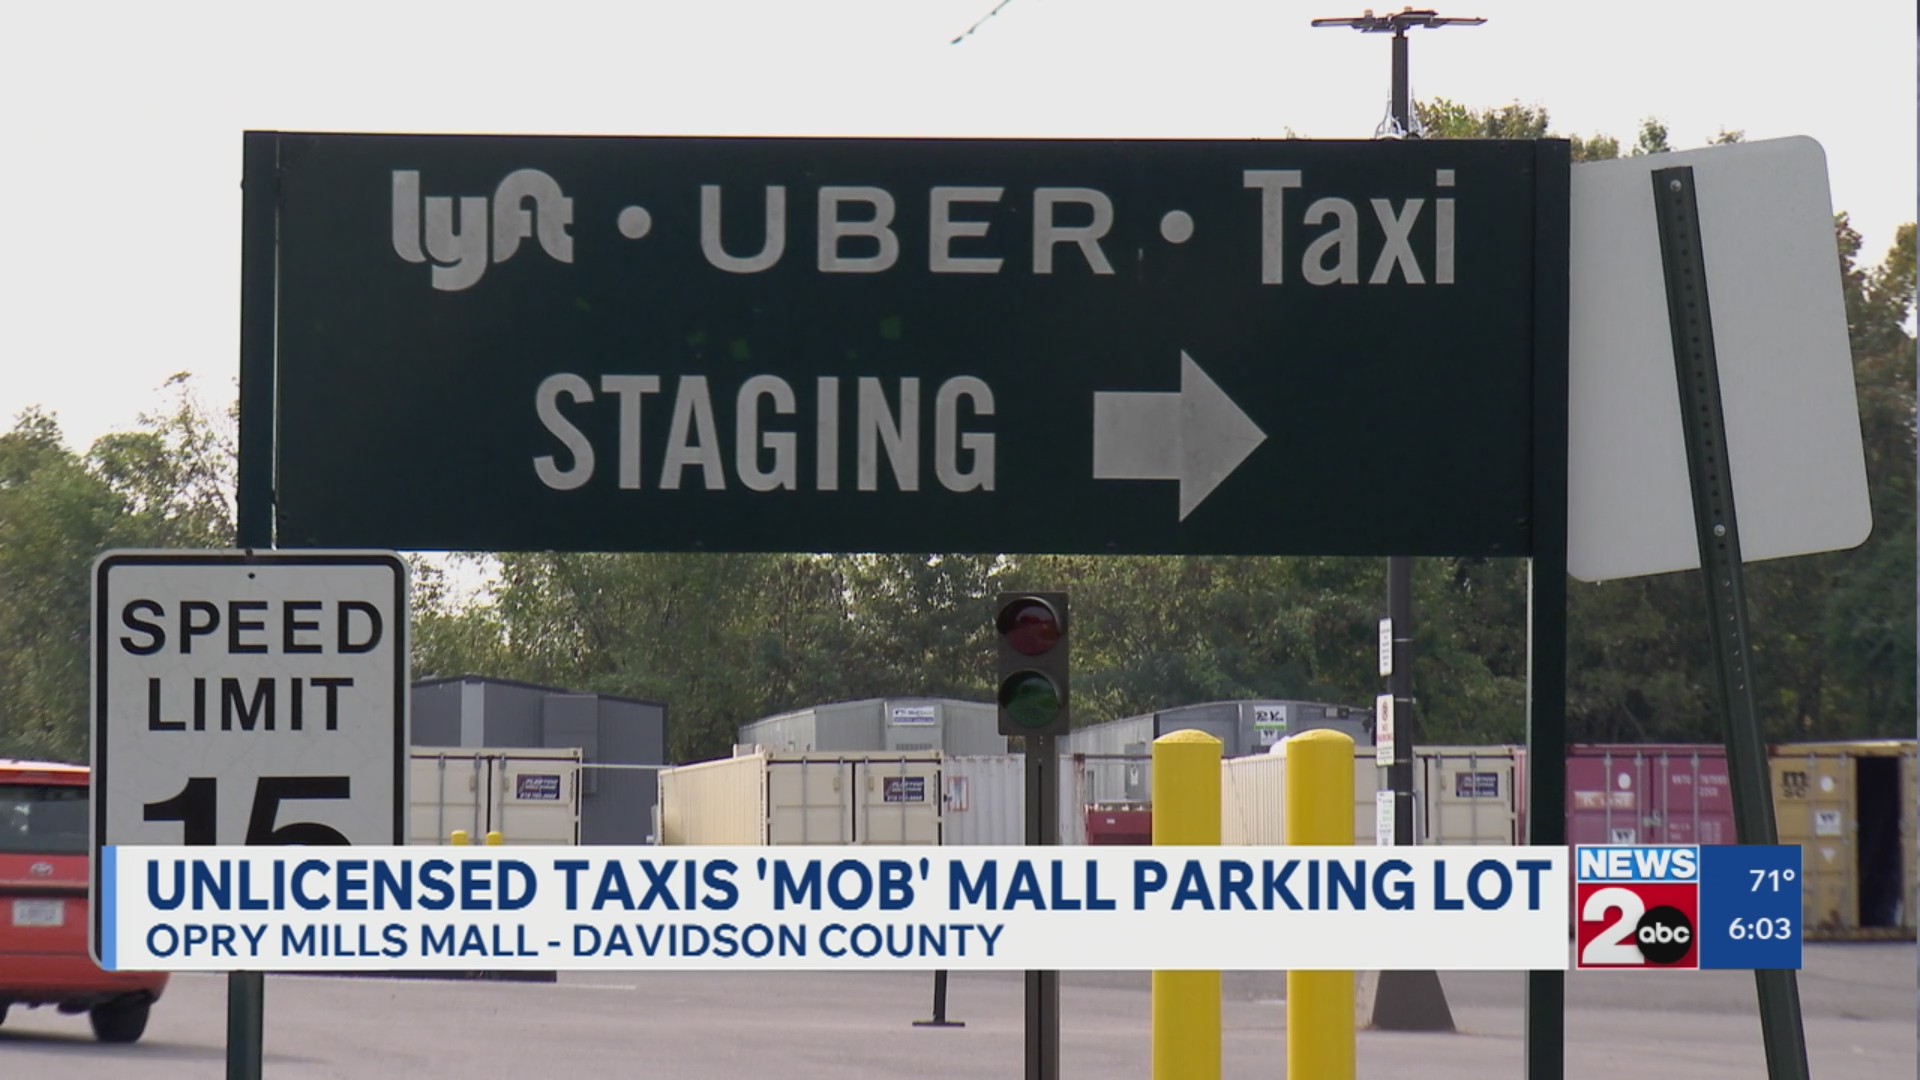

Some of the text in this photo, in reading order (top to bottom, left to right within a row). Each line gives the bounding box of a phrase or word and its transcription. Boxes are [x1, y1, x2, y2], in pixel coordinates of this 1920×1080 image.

[701, 185, 1115, 274] UBER
[1243, 169, 1456, 286] Taxi
[533, 373, 996, 492] STAGING
[119, 598, 383, 656] SPEED
[148, 677, 355, 731] LIMIT
